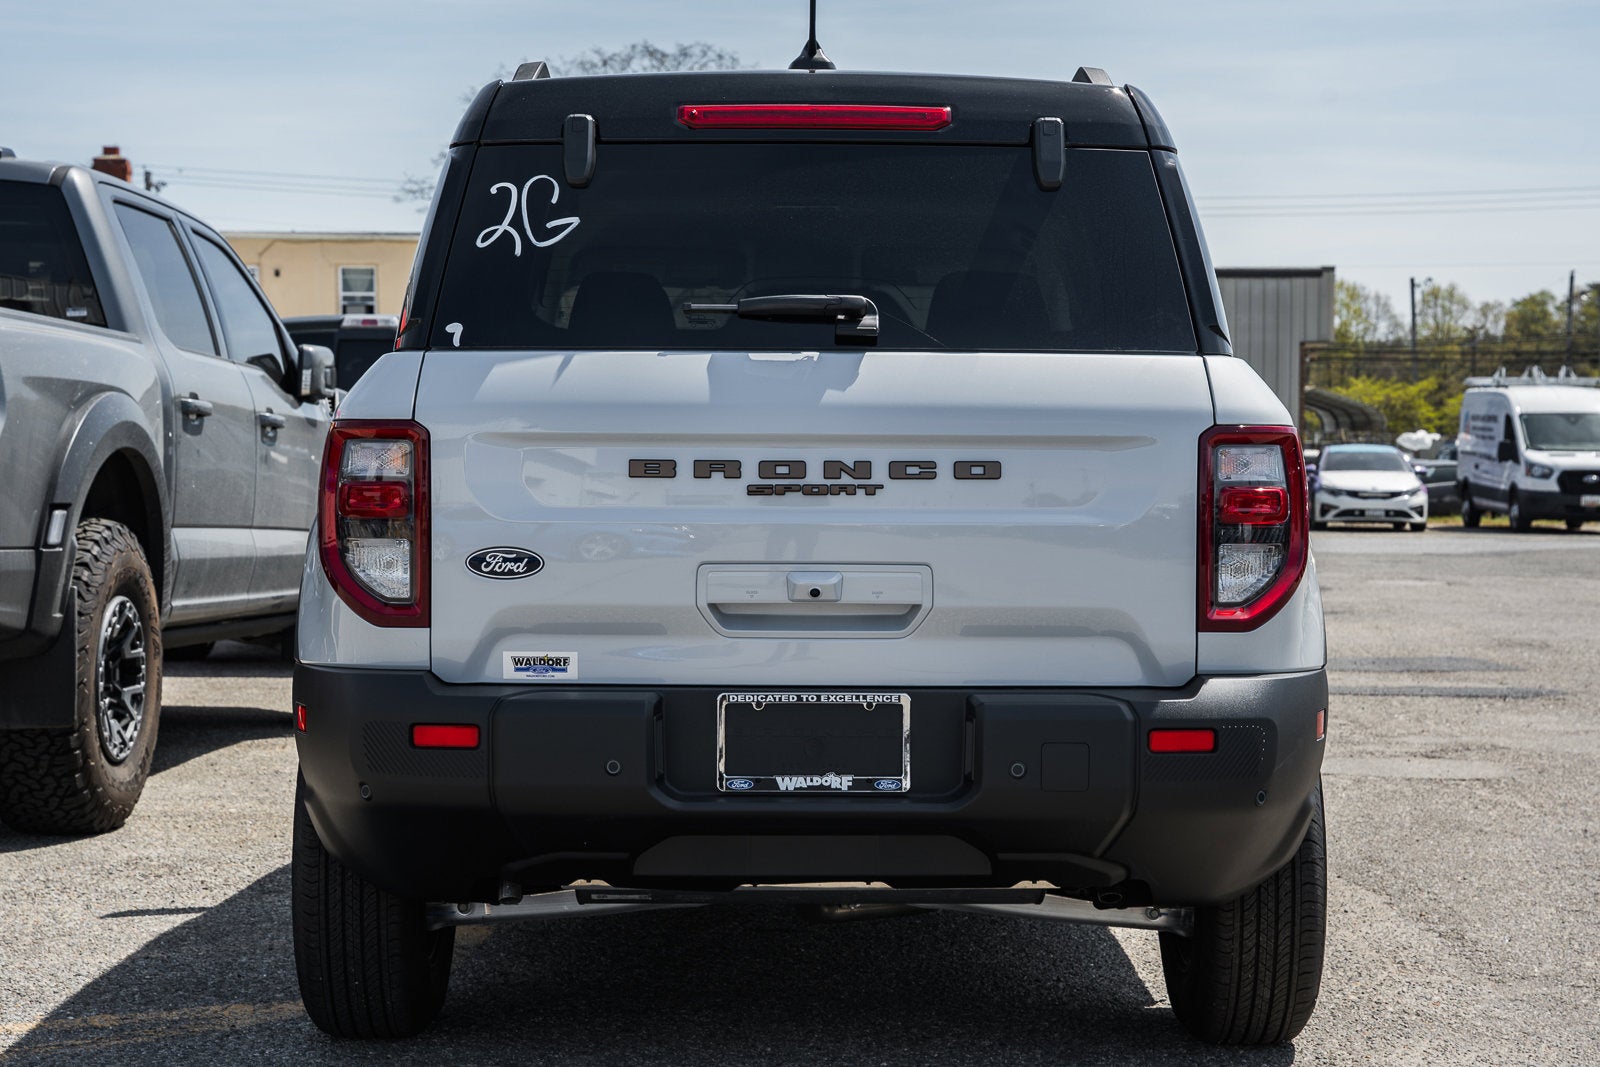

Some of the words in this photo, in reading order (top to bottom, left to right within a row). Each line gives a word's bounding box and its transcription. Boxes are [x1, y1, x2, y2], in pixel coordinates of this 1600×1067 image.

[476, 174, 580, 257] 2G
[628, 458, 1002, 480] BRONCO
[747, 484, 884, 496] SPORT
[481, 552, 528, 573] Ford
[511, 655, 570, 667] WALDORF
[729, 694, 798, 703] DEDICATED
[800, 694, 817, 703] TO
[820, 694, 900, 703] EXCELLENCE
[775, 774, 853, 791] WALDORF
